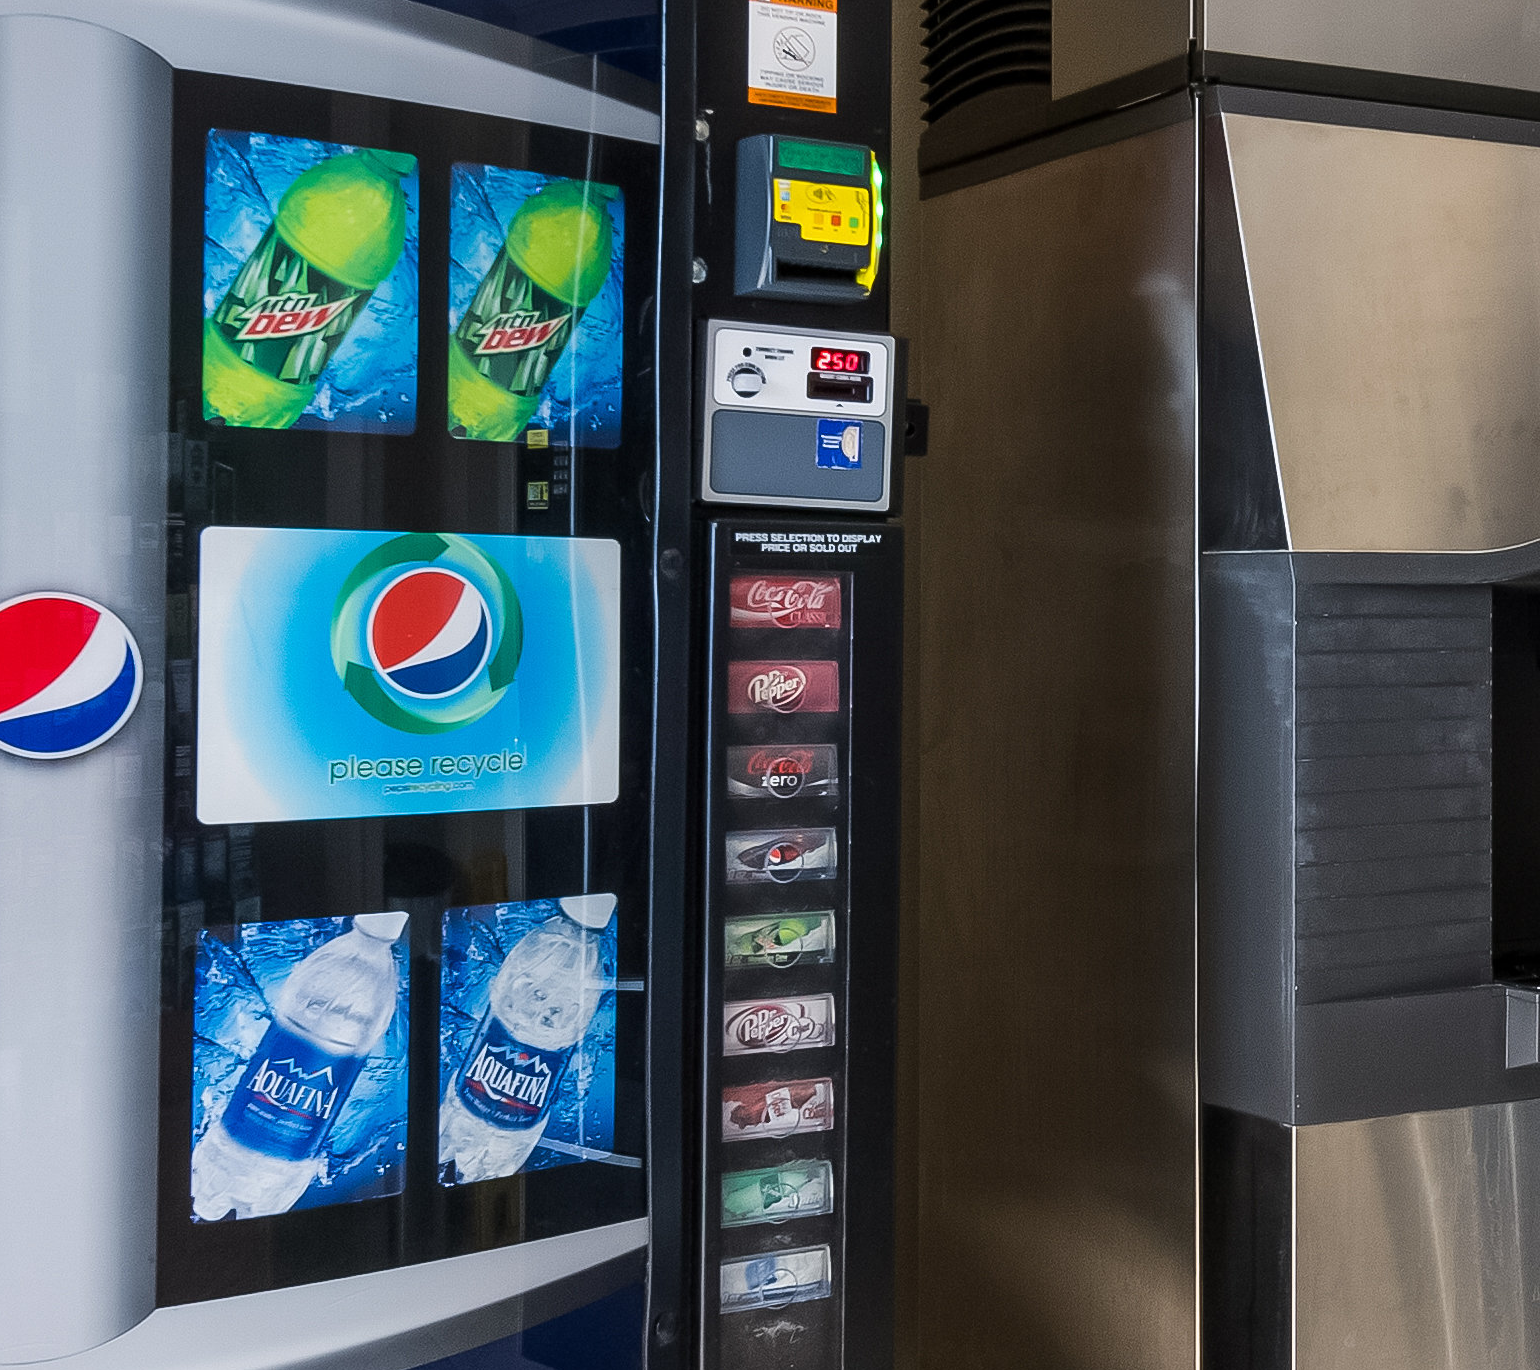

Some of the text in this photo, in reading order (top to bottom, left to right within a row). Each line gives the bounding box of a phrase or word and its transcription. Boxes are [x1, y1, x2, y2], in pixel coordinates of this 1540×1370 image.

[735, 533, 881, 543] PRESS SELECTION TO DISPLAY
[761, 544, 857, 553] PRICE OR SOLD OUT
[754, 673, 799, 703] Pepper
[330, 750, 523, 784] please recycle
[761, 775, 798, 787] zero
[246, 1058, 339, 1119] AQUAFINA
[466, 1042, 551, 1108] AQUAFINA
